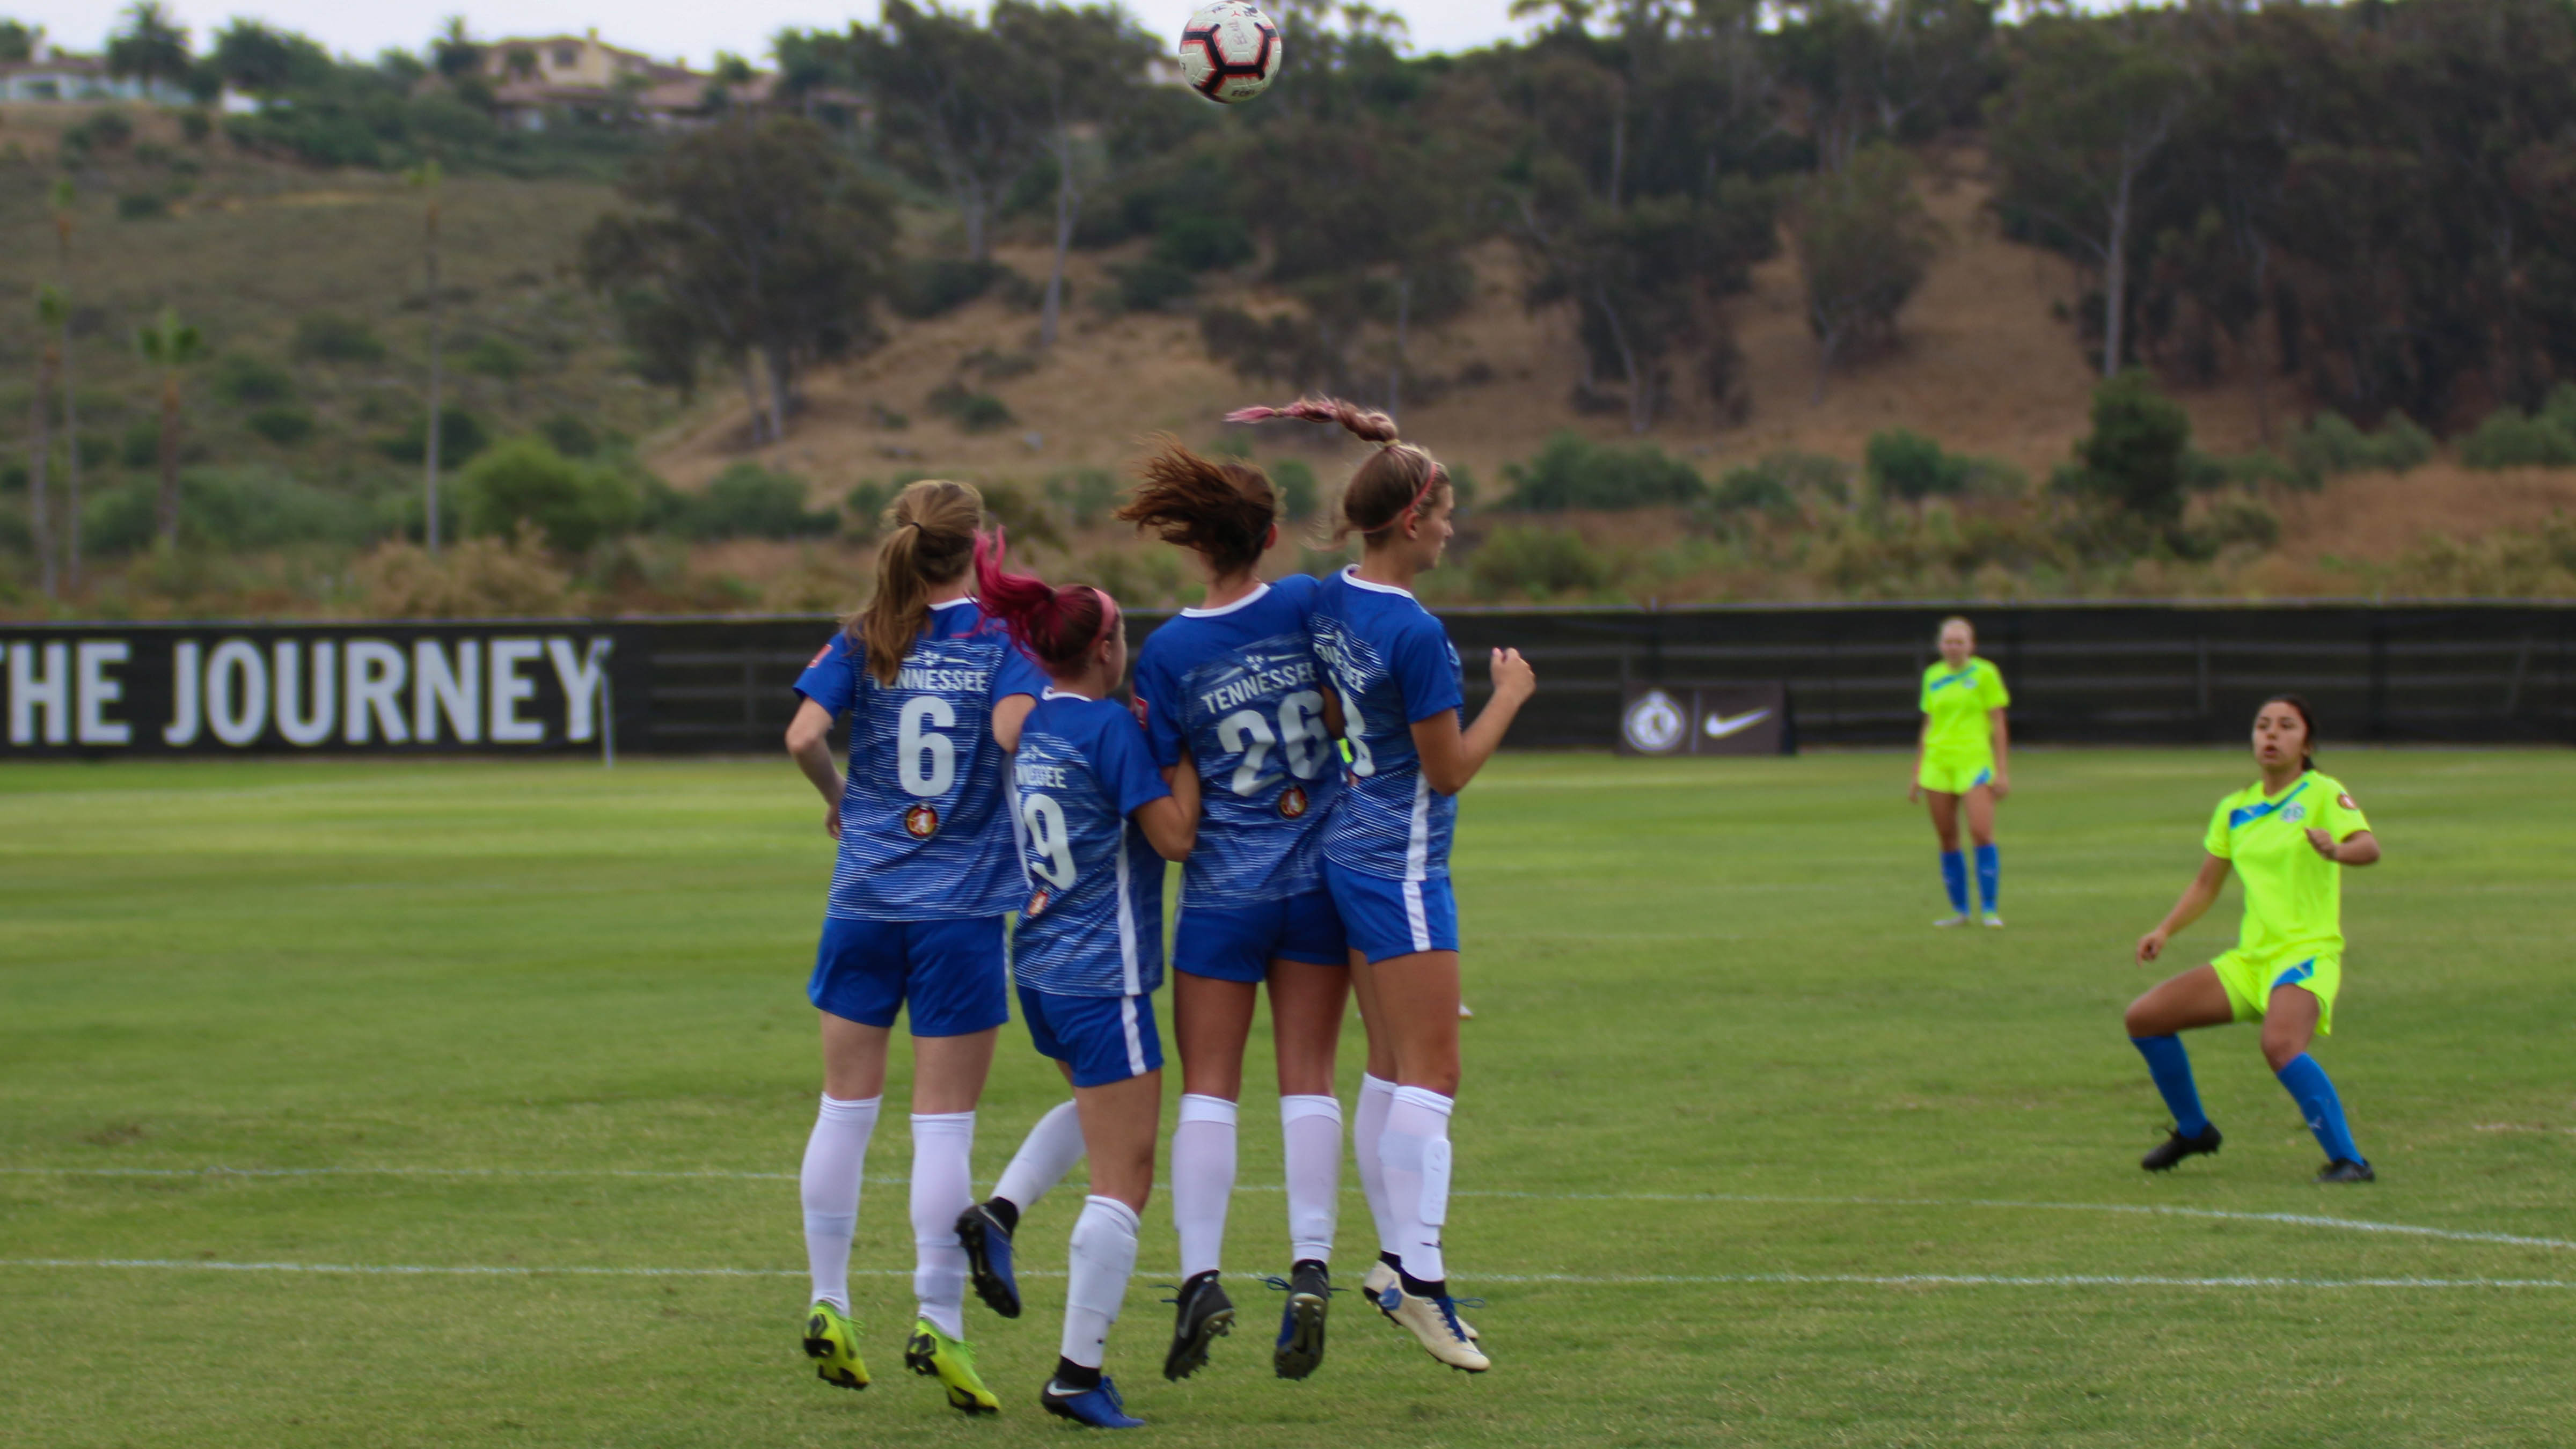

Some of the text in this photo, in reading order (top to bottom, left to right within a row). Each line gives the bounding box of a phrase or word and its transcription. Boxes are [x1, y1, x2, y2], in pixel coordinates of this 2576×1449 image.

[0, 639, 613, 744] HE JOURNEY
[1201, 662, 1318, 714] TENNESSEE
[898, 696, 955, 796] 6
[1217, 690, 1330, 797] 26
